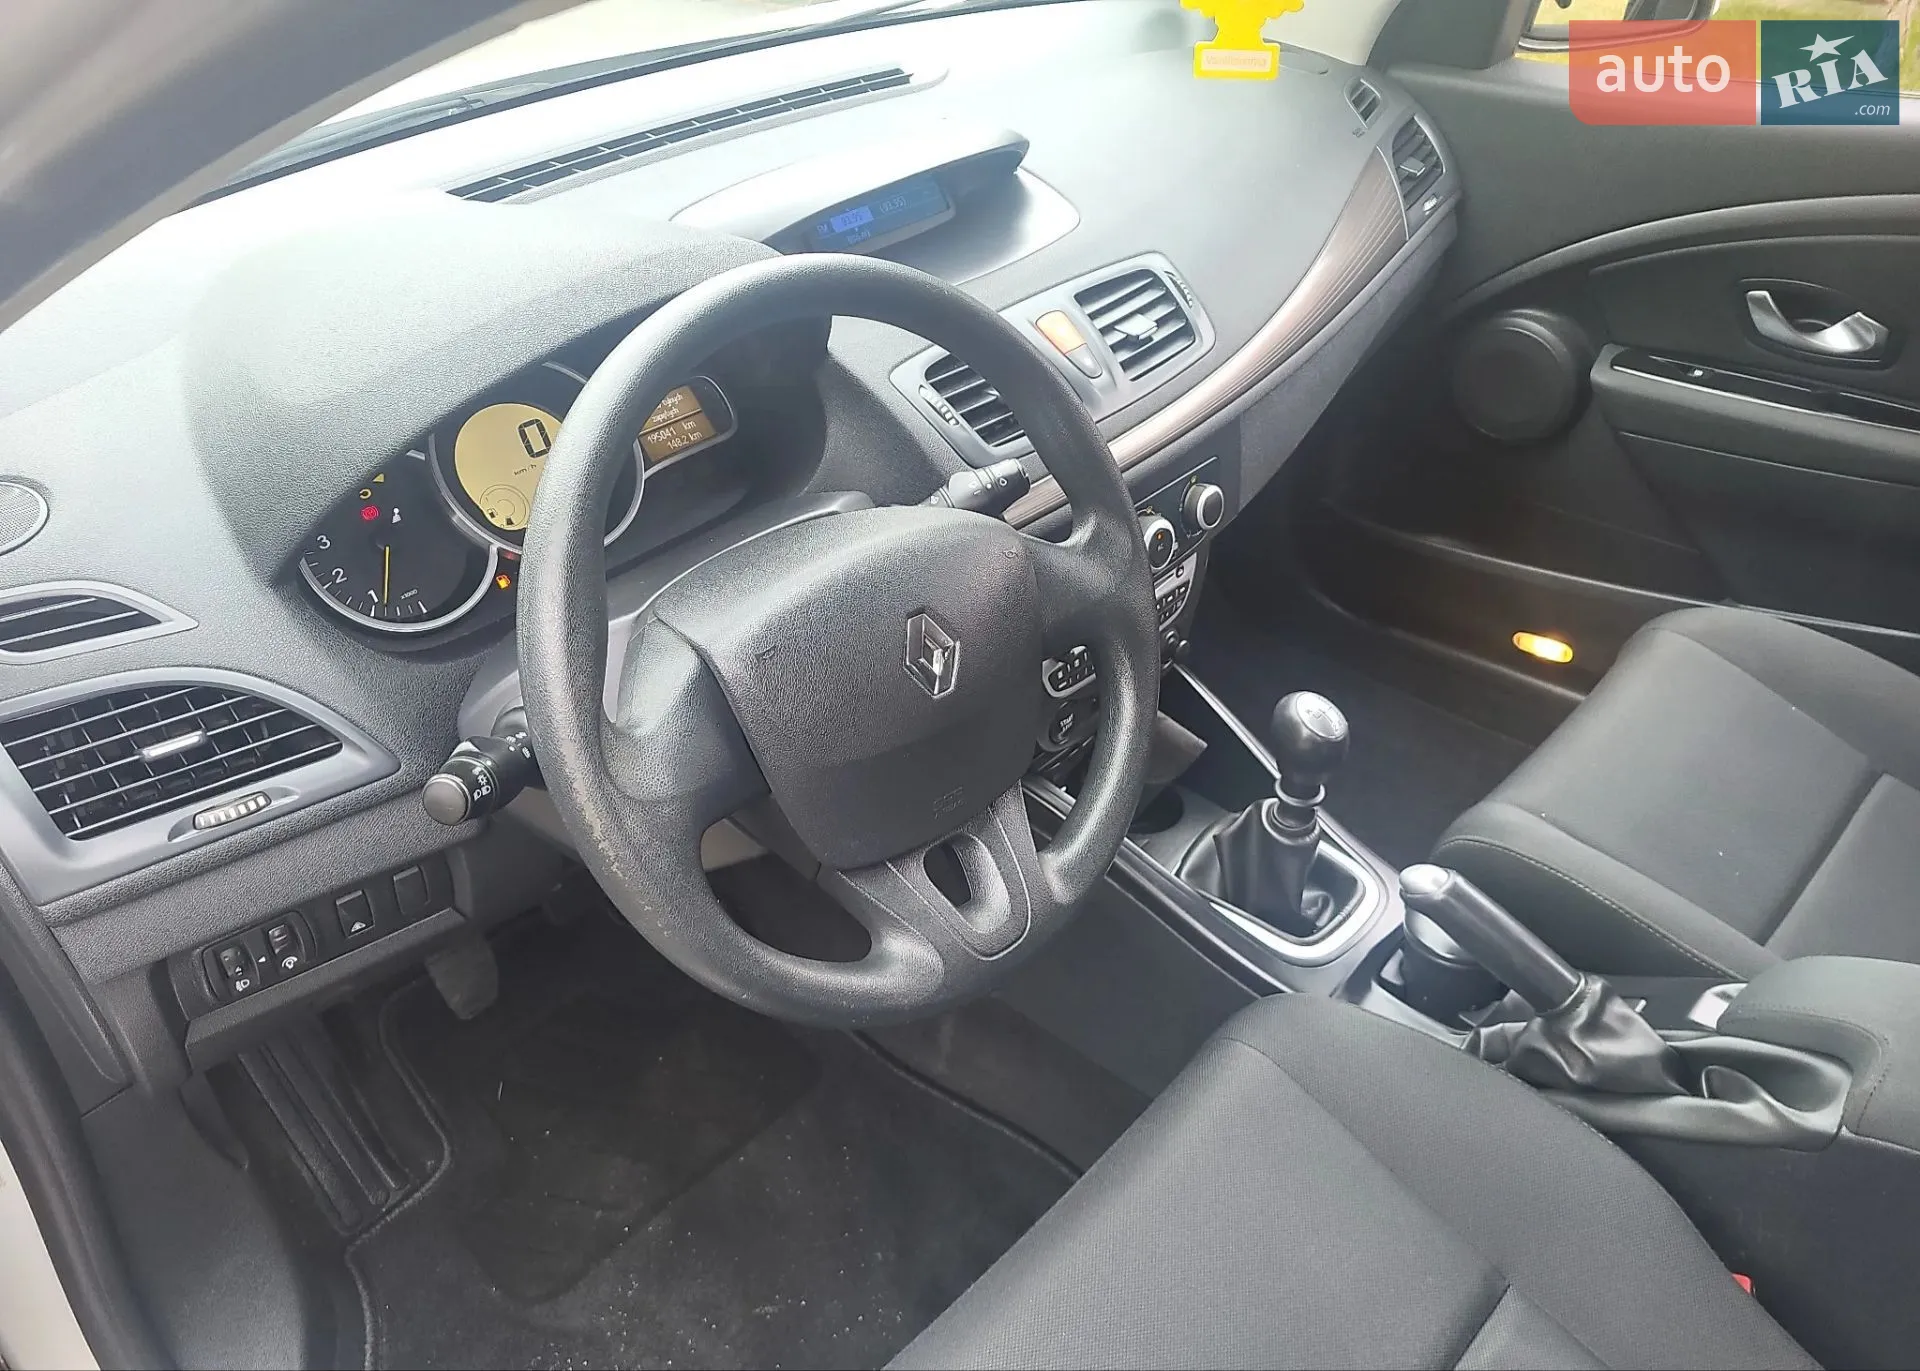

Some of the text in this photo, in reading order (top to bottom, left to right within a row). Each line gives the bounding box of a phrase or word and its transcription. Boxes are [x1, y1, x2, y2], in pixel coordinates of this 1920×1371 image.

[518, 418, 552, 458] 0
[647, 420, 697, 444] 195041 km
[688, 431, 703, 442] km
[316, 534, 331, 550] 3
[331, 567, 348, 584] 2
[367, 589, 379, 603] 1
